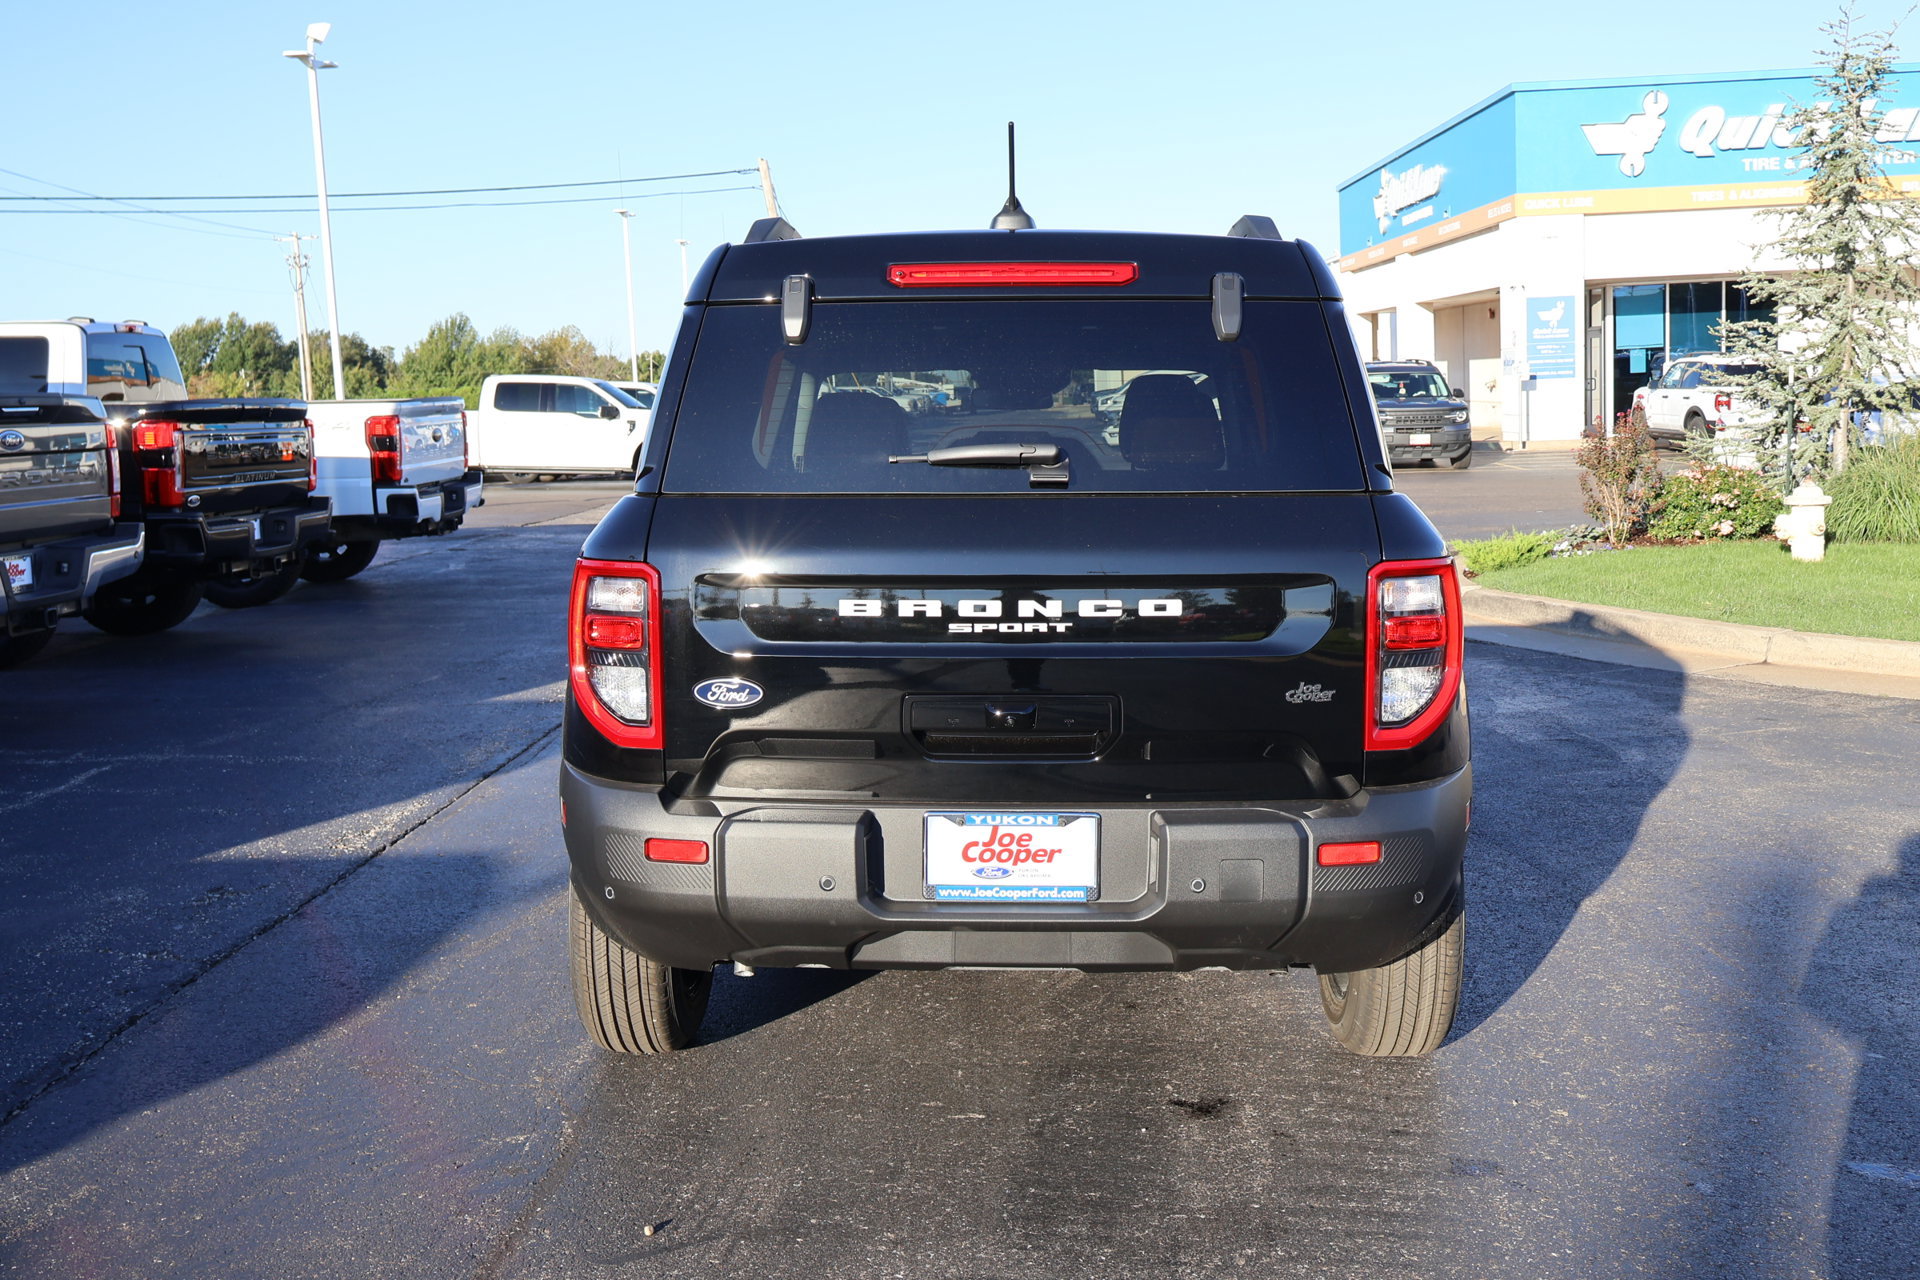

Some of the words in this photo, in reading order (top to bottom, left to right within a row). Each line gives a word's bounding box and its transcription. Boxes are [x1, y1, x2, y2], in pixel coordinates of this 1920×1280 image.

[1741, 157, 1780, 171] TIRE
[1783, 157, 1796, 169] &
[234, 471, 276, 483] PLATINUM
[838, 598, 1183, 618] BRONCO
[947, 622, 1073, 634] SPORT
[706, 682, 750, 703] Ford
[1295, 681, 1322, 694] Joe
[1285, 689, 1337, 702] Cooper
[970, 815, 1054, 825] YUKON
[982, 826, 1033, 848] Joe
[961, 841, 1063, 866] Cooper
[938, 887, 1085, 900] www.JoeCooperFord.com
